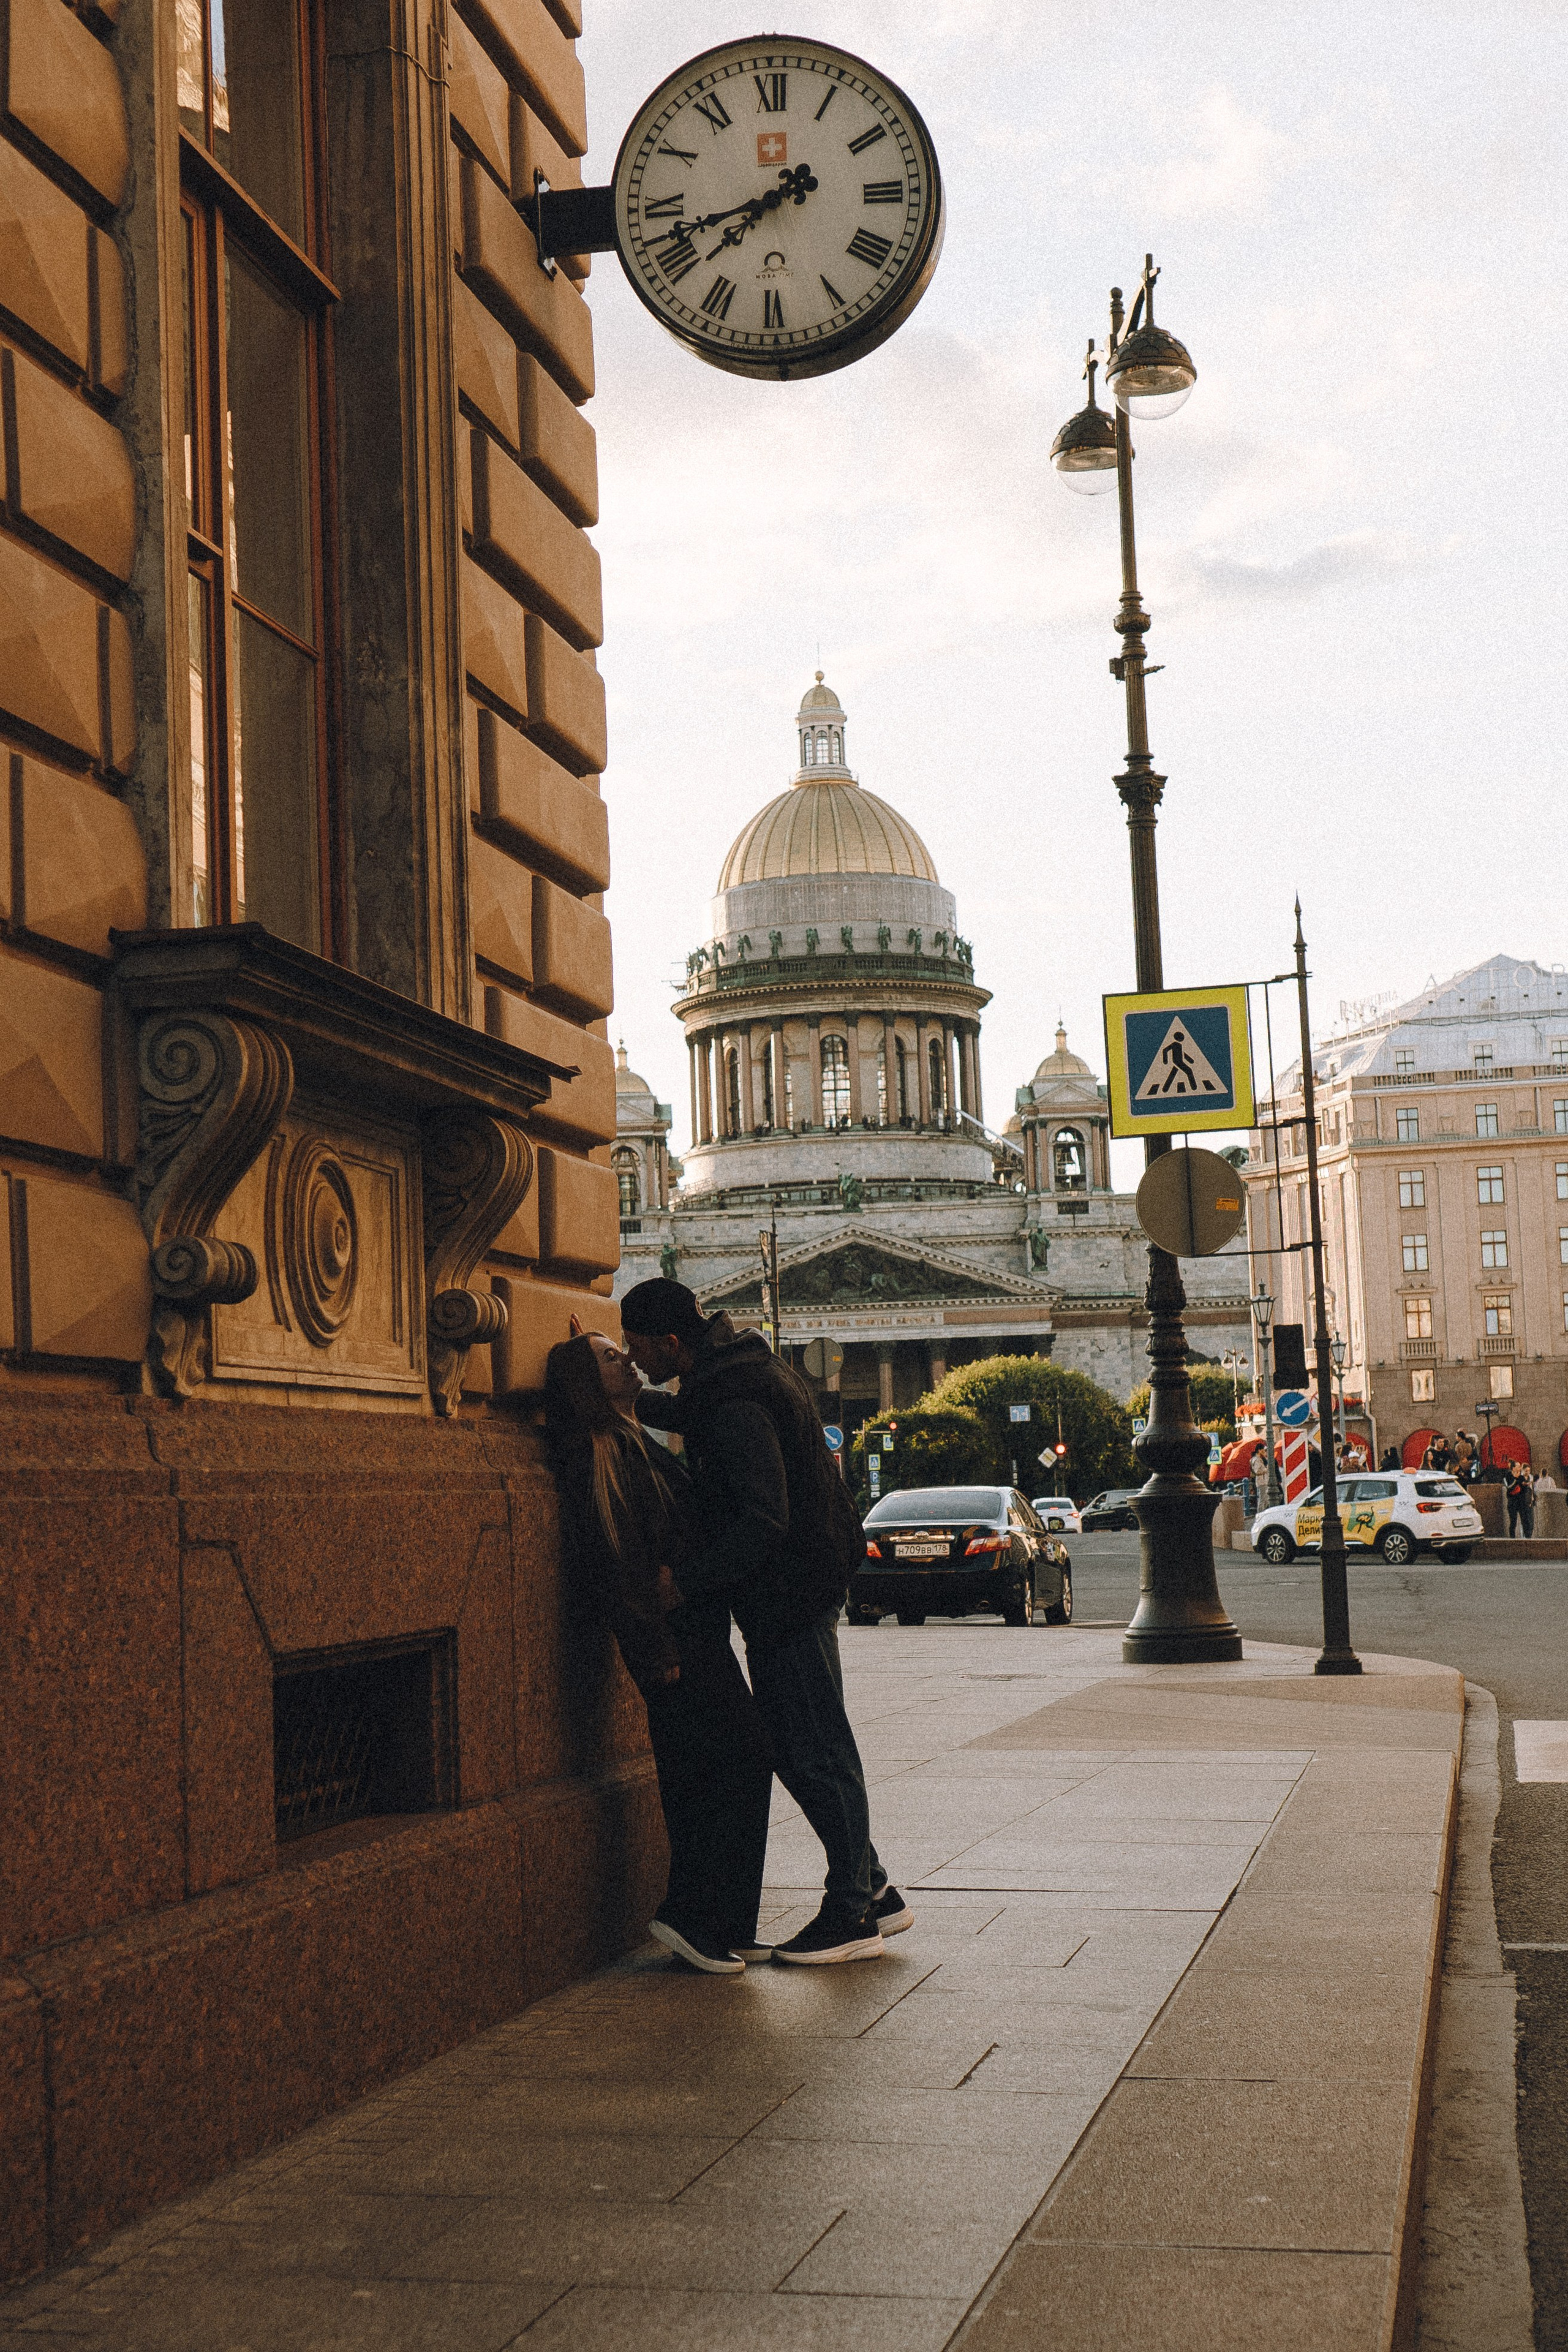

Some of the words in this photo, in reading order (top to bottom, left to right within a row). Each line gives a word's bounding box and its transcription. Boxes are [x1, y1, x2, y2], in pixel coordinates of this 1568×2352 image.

[753, 73, 788, 113] XII
[814, 84, 838, 121] I
[692, 90, 733, 135] XI
[657, 138, 699, 168] X
[847, 123, 888, 157] II
[863, 179, 903, 205] III
[820, 274, 846, 311] V
[1298, 1514, 1322, 1525] Марк
[1298, 1525, 1322, 1537] Дели
